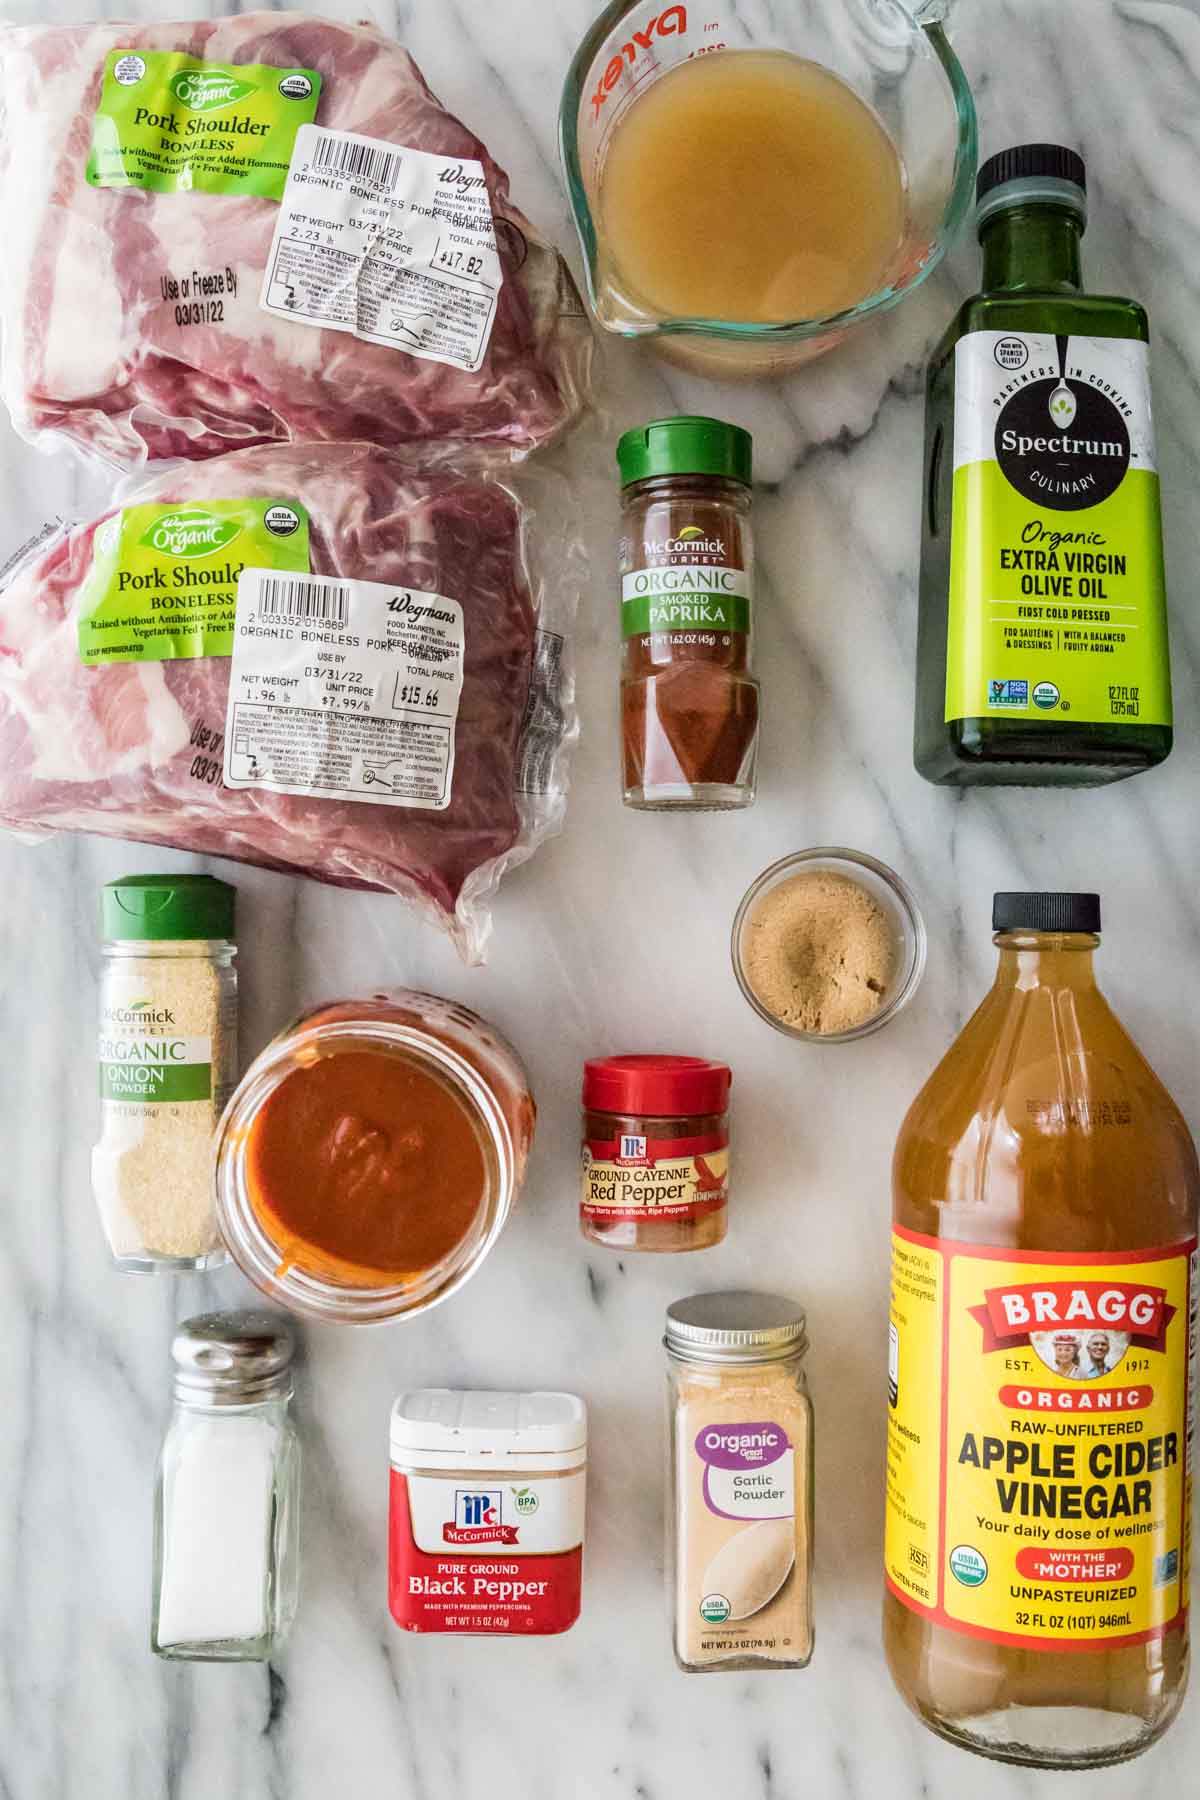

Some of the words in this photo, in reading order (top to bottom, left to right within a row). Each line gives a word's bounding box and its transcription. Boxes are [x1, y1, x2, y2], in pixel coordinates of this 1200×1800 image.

[176, 81, 239, 107] Organic
[134, 108, 178, 134] Pork
[184, 116, 270, 136] Shoulder
[160, 138, 234, 152] BONELESS
[129, 148, 162, 161] without
[218, 155, 246, 166] Added
[202, 162, 223, 173] Free
[293, 173, 343, 191] ORGANIC
[437, 164, 487, 193] Wegm
[289, 213, 307, 224] NET
[308, 217, 345, 232] WEIGHT
[290, 227, 320, 242] 2.23
[449, 233, 475, 246] TOTAL
[386, 240, 413, 256] PRICE
[440, 251, 484, 276] $17.82
[160, 275, 179, 301] Use
[181, 279, 189, 298] or
[192, 271, 224, 297] Freeze
[225, 267, 237, 299] By
[175, 300, 224, 326] 03/31/22
[993, 366, 1055, 407] PARTNERS
[1069, 368, 1083, 378] IN
[1089, 374, 1133, 417] COOKING
[1001, 430, 1124, 459] Spectrum
[1030, 471, 1097, 494] CULINARY
[272, 512, 292, 520] USDA
[154, 526, 224, 554] Organic
[1021, 520, 1107, 551] Organic
[644, 538, 727, 556] McCormick
[1000, 548, 1059, 573] EXTRA
[1063, 551, 1127, 577] VIRGIN
[118, 567, 168, 591] Pork
[172, 562, 244, 588] Should
[634, 569, 736, 592] ORGANIC
[1021, 575, 1073, 598] OLIVE
[1078, 577, 1108, 600] OIL
[151, 592, 234, 610] BONELESS
[386, 593, 457, 624] Wegmans
[660, 594, 709, 605] SMOKED
[91, 617, 120, 630] Raised
[121, 614, 155, 627] without
[156, 611, 206, 625] Antibiotics
[207, 613, 218, 622] or
[649, 606, 726, 622] PAPRIKA
[1018, 606, 1043, 618] FIRST
[1046, 607, 1069, 619] COLD
[1071, 609, 1111, 622] PRESSED
[132, 625, 181, 640] Vegetarian
[183, 624, 198, 635] Fed
[207, 622, 228, 634] Free
[387, 619, 406, 629] FOOD
[1004, 627, 1018, 637] FOR
[240, 625, 294, 640] ORGANIC
[301, 631, 360, 647] BONELESS
[669, 635, 684, 645] 1.62
[685, 635, 697, 645] OZ
[1013, 640, 1052, 650] DRESSINGS
[1063, 630, 1081, 641] WITH
[1083, 631, 1089, 641] A
[1090, 631, 1126, 643] BALANCED
[1063, 642, 1088, 653] FRUITY
[1090, 644, 1114, 654] AROMA
[317, 653, 333, 662] USE
[333, 654, 346, 664] BY
[241, 674, 260, 685] NET
[261, 675, 299, 688] WEIGHT
[304, 666, 363, 684] 03/31/22
[406, 666, 431, 677] TOTAL
[432, 669, 456, 682] PRICE
[246, 688, 275, 702] 1.96
[325, 683, 345, 695] UNIT
[346, 685, 374, 697] PRICE
[400, 685, 439, 707] $15.66
[190, 718, 209, 749] Use
[108, 1066, 165, 1083] ONION
[589, 1170, 631, 1182] GROUND
[634, 1168, 690, 1182] CAYENNE
[591, 1183, 616, 1201] Red
[623, 1184, 686, 1206] Pepper
[1001, 1290, 1155, 1326] BRAGG
[1005, 1359, 1034, 1372] EST.
[1125, 1359, 1150, 1372] 1912
[1017, 1390, 1140, 1409] ORGANIC
[704, 1430, 778, 1453] Organic
[958, 1432, 1076, 1479] APPLE
[1088, 1433, 1178, 1479] CIDER
[733, 1474, 773, 1486] Garlic
[517, 1497, 536, 1506] BPA
[734, 1489, 784, 1501] Powder
[995, 1478, 1153, 1520] VINEGAR
[447, 1527, 510, 1542] McCormick
[976, 1515, 1010, 1533] Your
[1014, 1523, 1050, 1542] daily
[1055, 1526, 1092, 1541] dose
[1095, 1525, 1110, 1540] of
[1049, 1552, 1081, 1562] WITH
[1084, 1552, 1106, 1562] THE
[438, 1564, 467, 1575] PURE
[469, 1564, 519, 1576] GROUND
[408, 1577, 466, 1597] Black
[473, 1579, 548, 1602] Pepper
[1010, 1586, 1137, 1603] UNPASTEURIZED
[424, 1602, 443, 1610] MADE
[443, 1602, 459, 1610] WITH
[445, 1616, 458, 1626] NET
[459, 1616, 470, 1626] WT
[472, 1616, 481, 1626] 1.5
[483, 1616, 492, 1626] OZ
[1016, 1612, 1030, 1625] 32
[1032, 1614, 1046, 1627] FL
[1049, 1615, 1064, 1629] OZ
[1099, 1611, 1131, 1628] 946mL
[701, 1640, 715, 1650] NET
[716, 1640, 727, 1649] WT
[728, 1640, 740, 1649] 2.5
[741, 1640, 750, 1649] OZ
